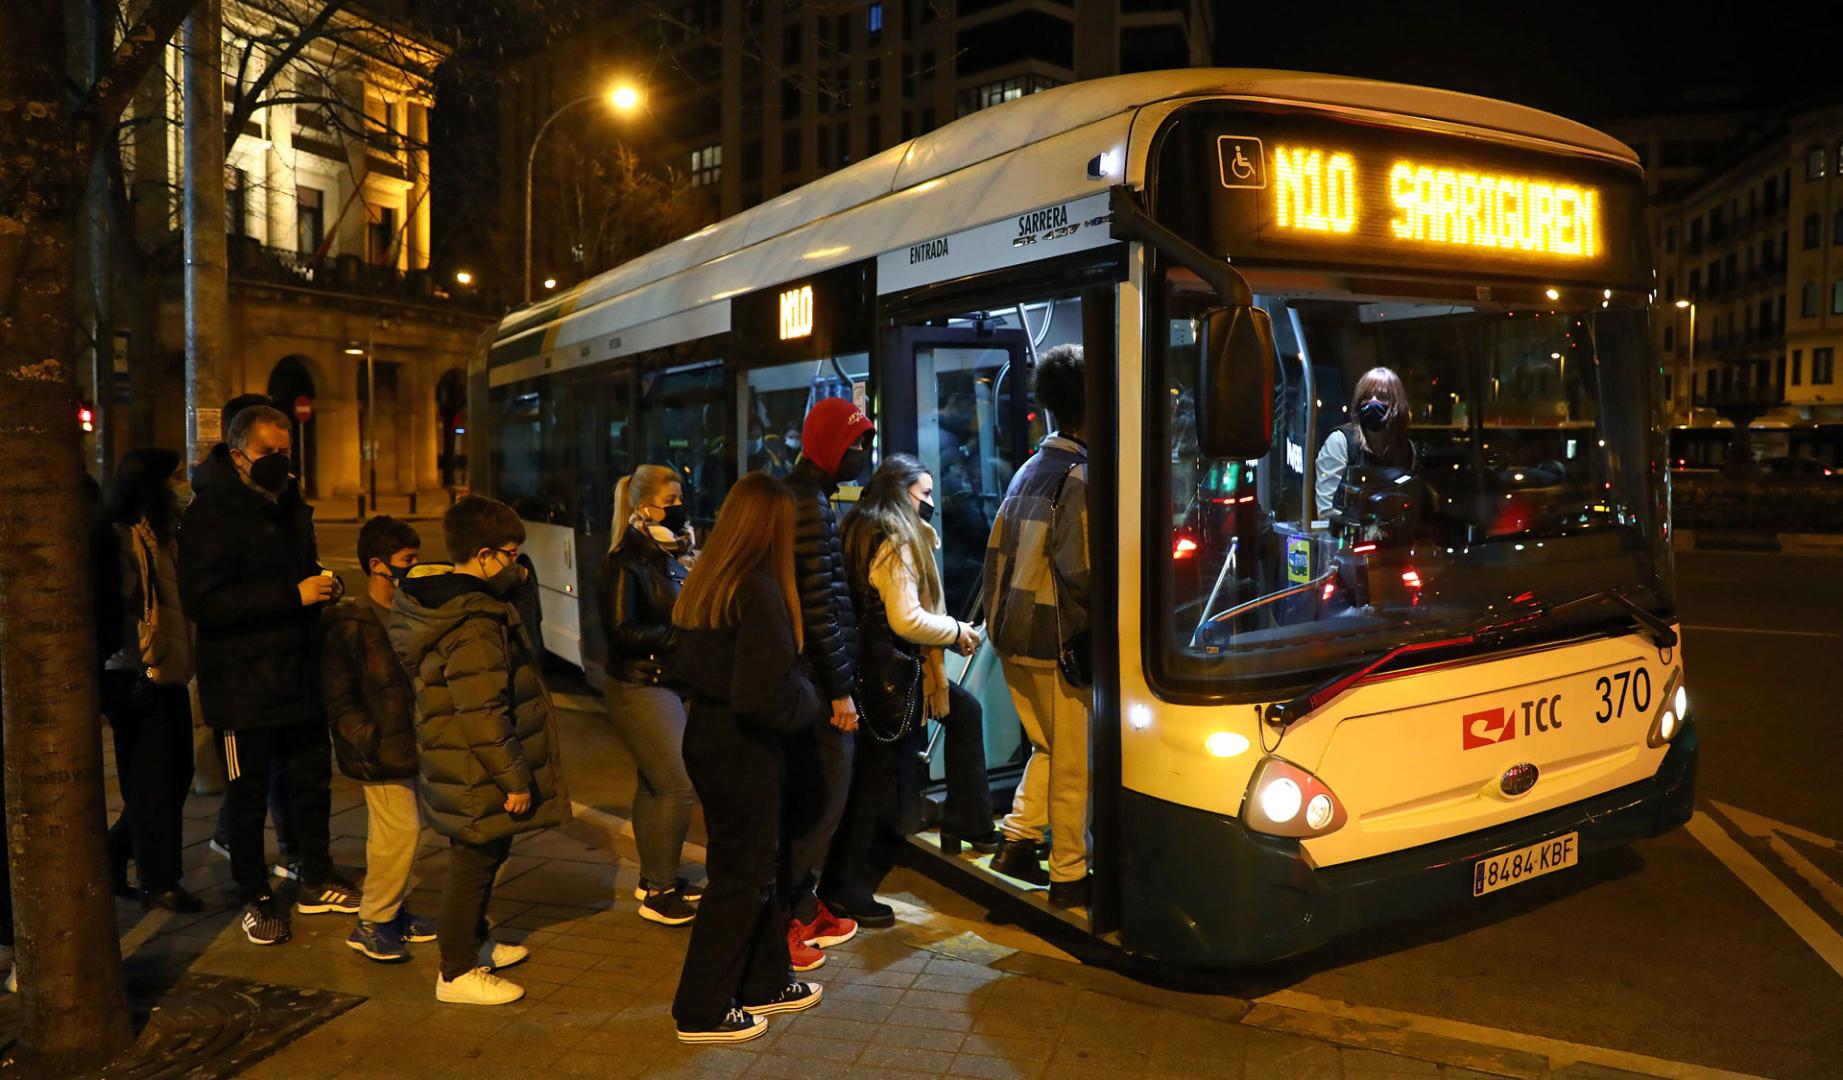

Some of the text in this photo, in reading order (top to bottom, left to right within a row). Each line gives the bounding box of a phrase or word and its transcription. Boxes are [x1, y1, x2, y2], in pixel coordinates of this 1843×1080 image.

[1018, 205, 1068, 237] SARRERA
[1274, 143, 1600, 258] N10 SARRIGUREN
[910, 238, 949, 265] ENTRADA
[779, 285, 814, 341] N10
[1521, 694, 1563, 736] TCC
[1595, 667, 1651, 724] 370
[1487, 837, 1574, 886] 8484 KBF
